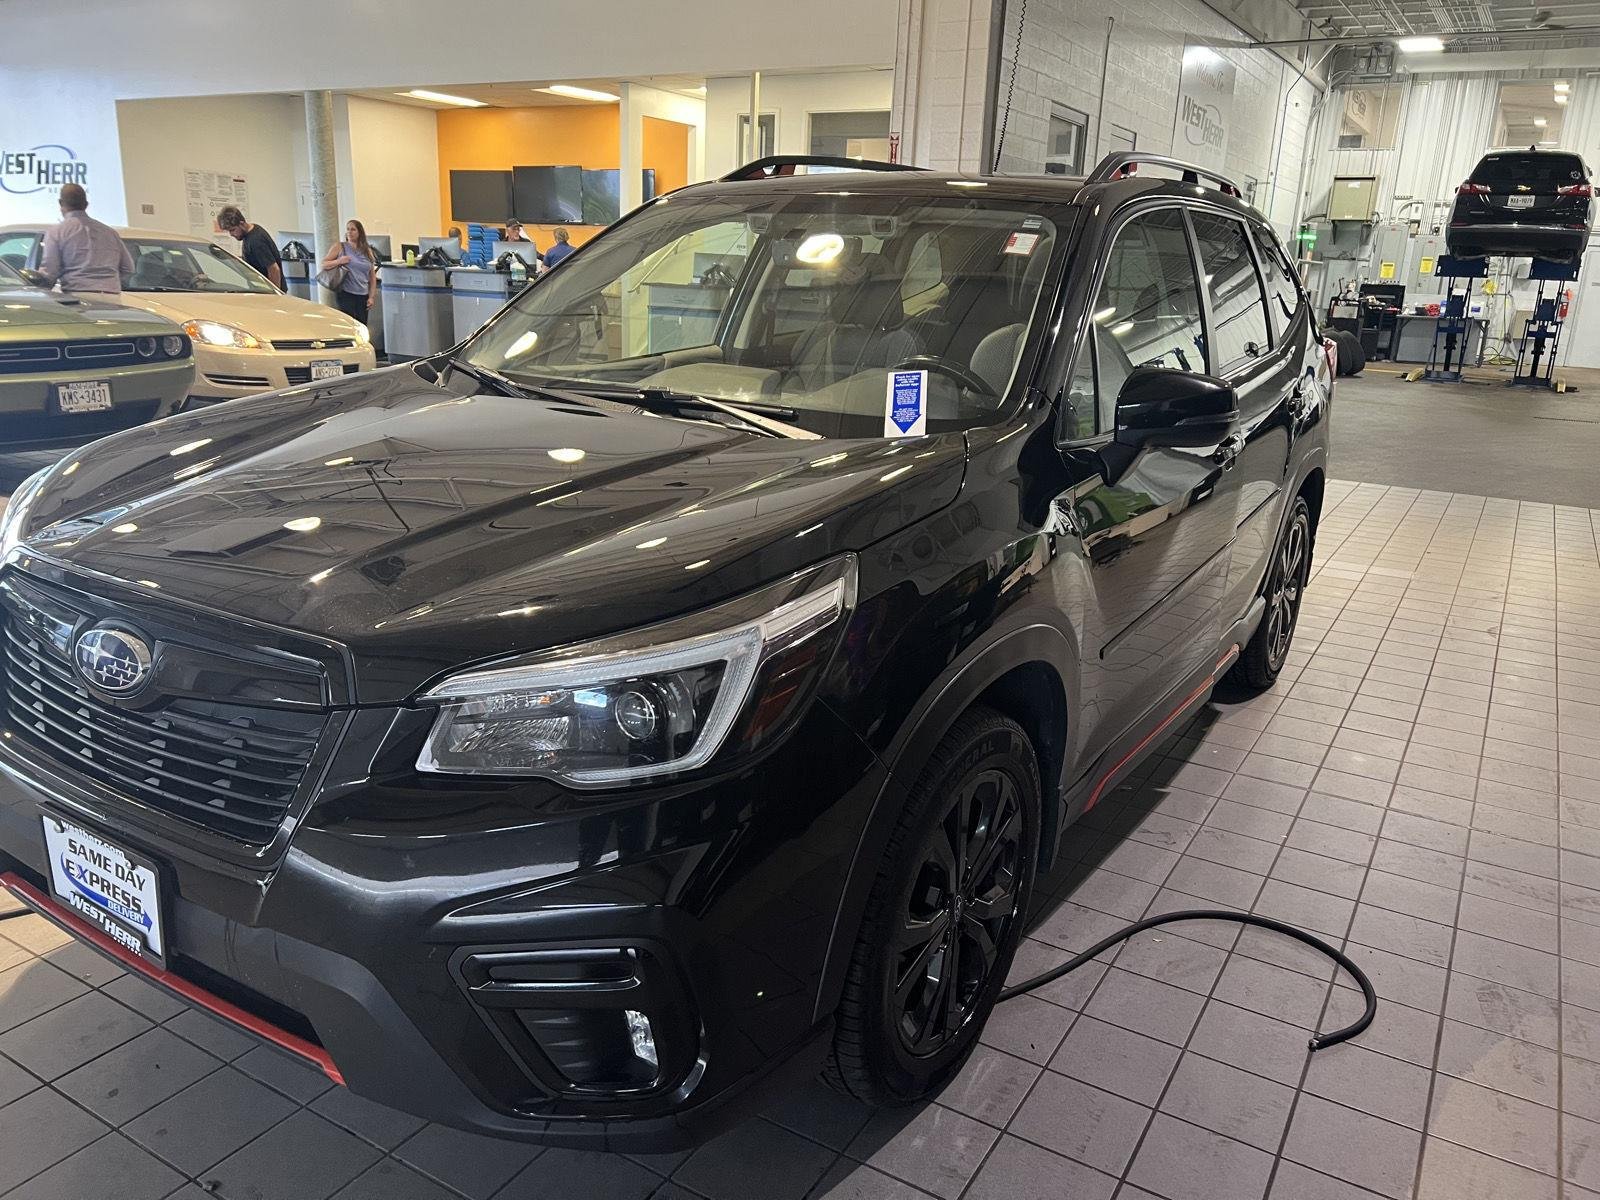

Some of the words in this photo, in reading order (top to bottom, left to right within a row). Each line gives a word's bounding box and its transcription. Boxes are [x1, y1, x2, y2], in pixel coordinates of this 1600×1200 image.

[1182, 95, 1208, 129] WEST
[1202, 117, 1224, 149] HERR
[37, 159, 87, 185] HERR
[65, 858, 142, 913] EXPRESS
[68, 838, 112, 875] SAME
[115, 865, 146, 892] DAY
[70, 890, 107, 924] WEST
[104, 919, 142, 950] HERR
[107, 898, 145, 924] DELIVERY
